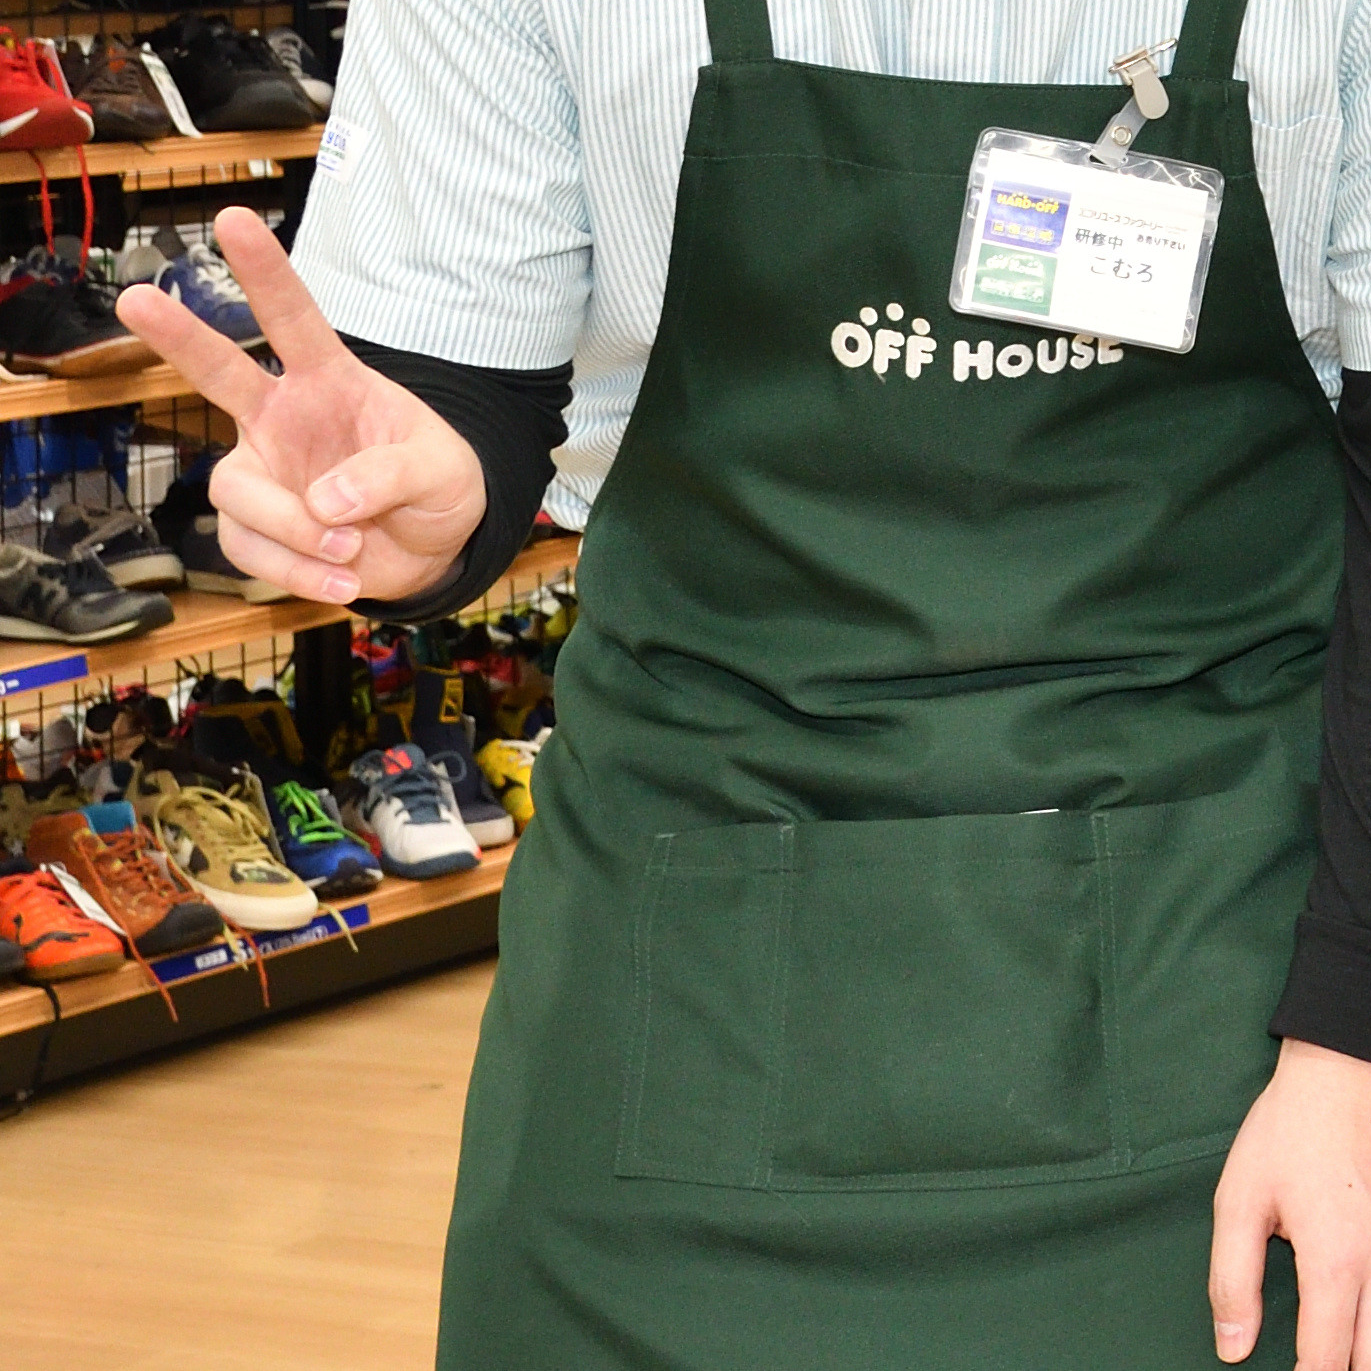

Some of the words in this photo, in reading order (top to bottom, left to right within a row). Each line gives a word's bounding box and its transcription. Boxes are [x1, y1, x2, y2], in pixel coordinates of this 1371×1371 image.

[1074, 228, 1124, 250] 研修中
[1090, 256, 1154, 284] こむろ
[831, 316, 938, 380] OFF
[952, 333, 1125, 383] HOUSE
